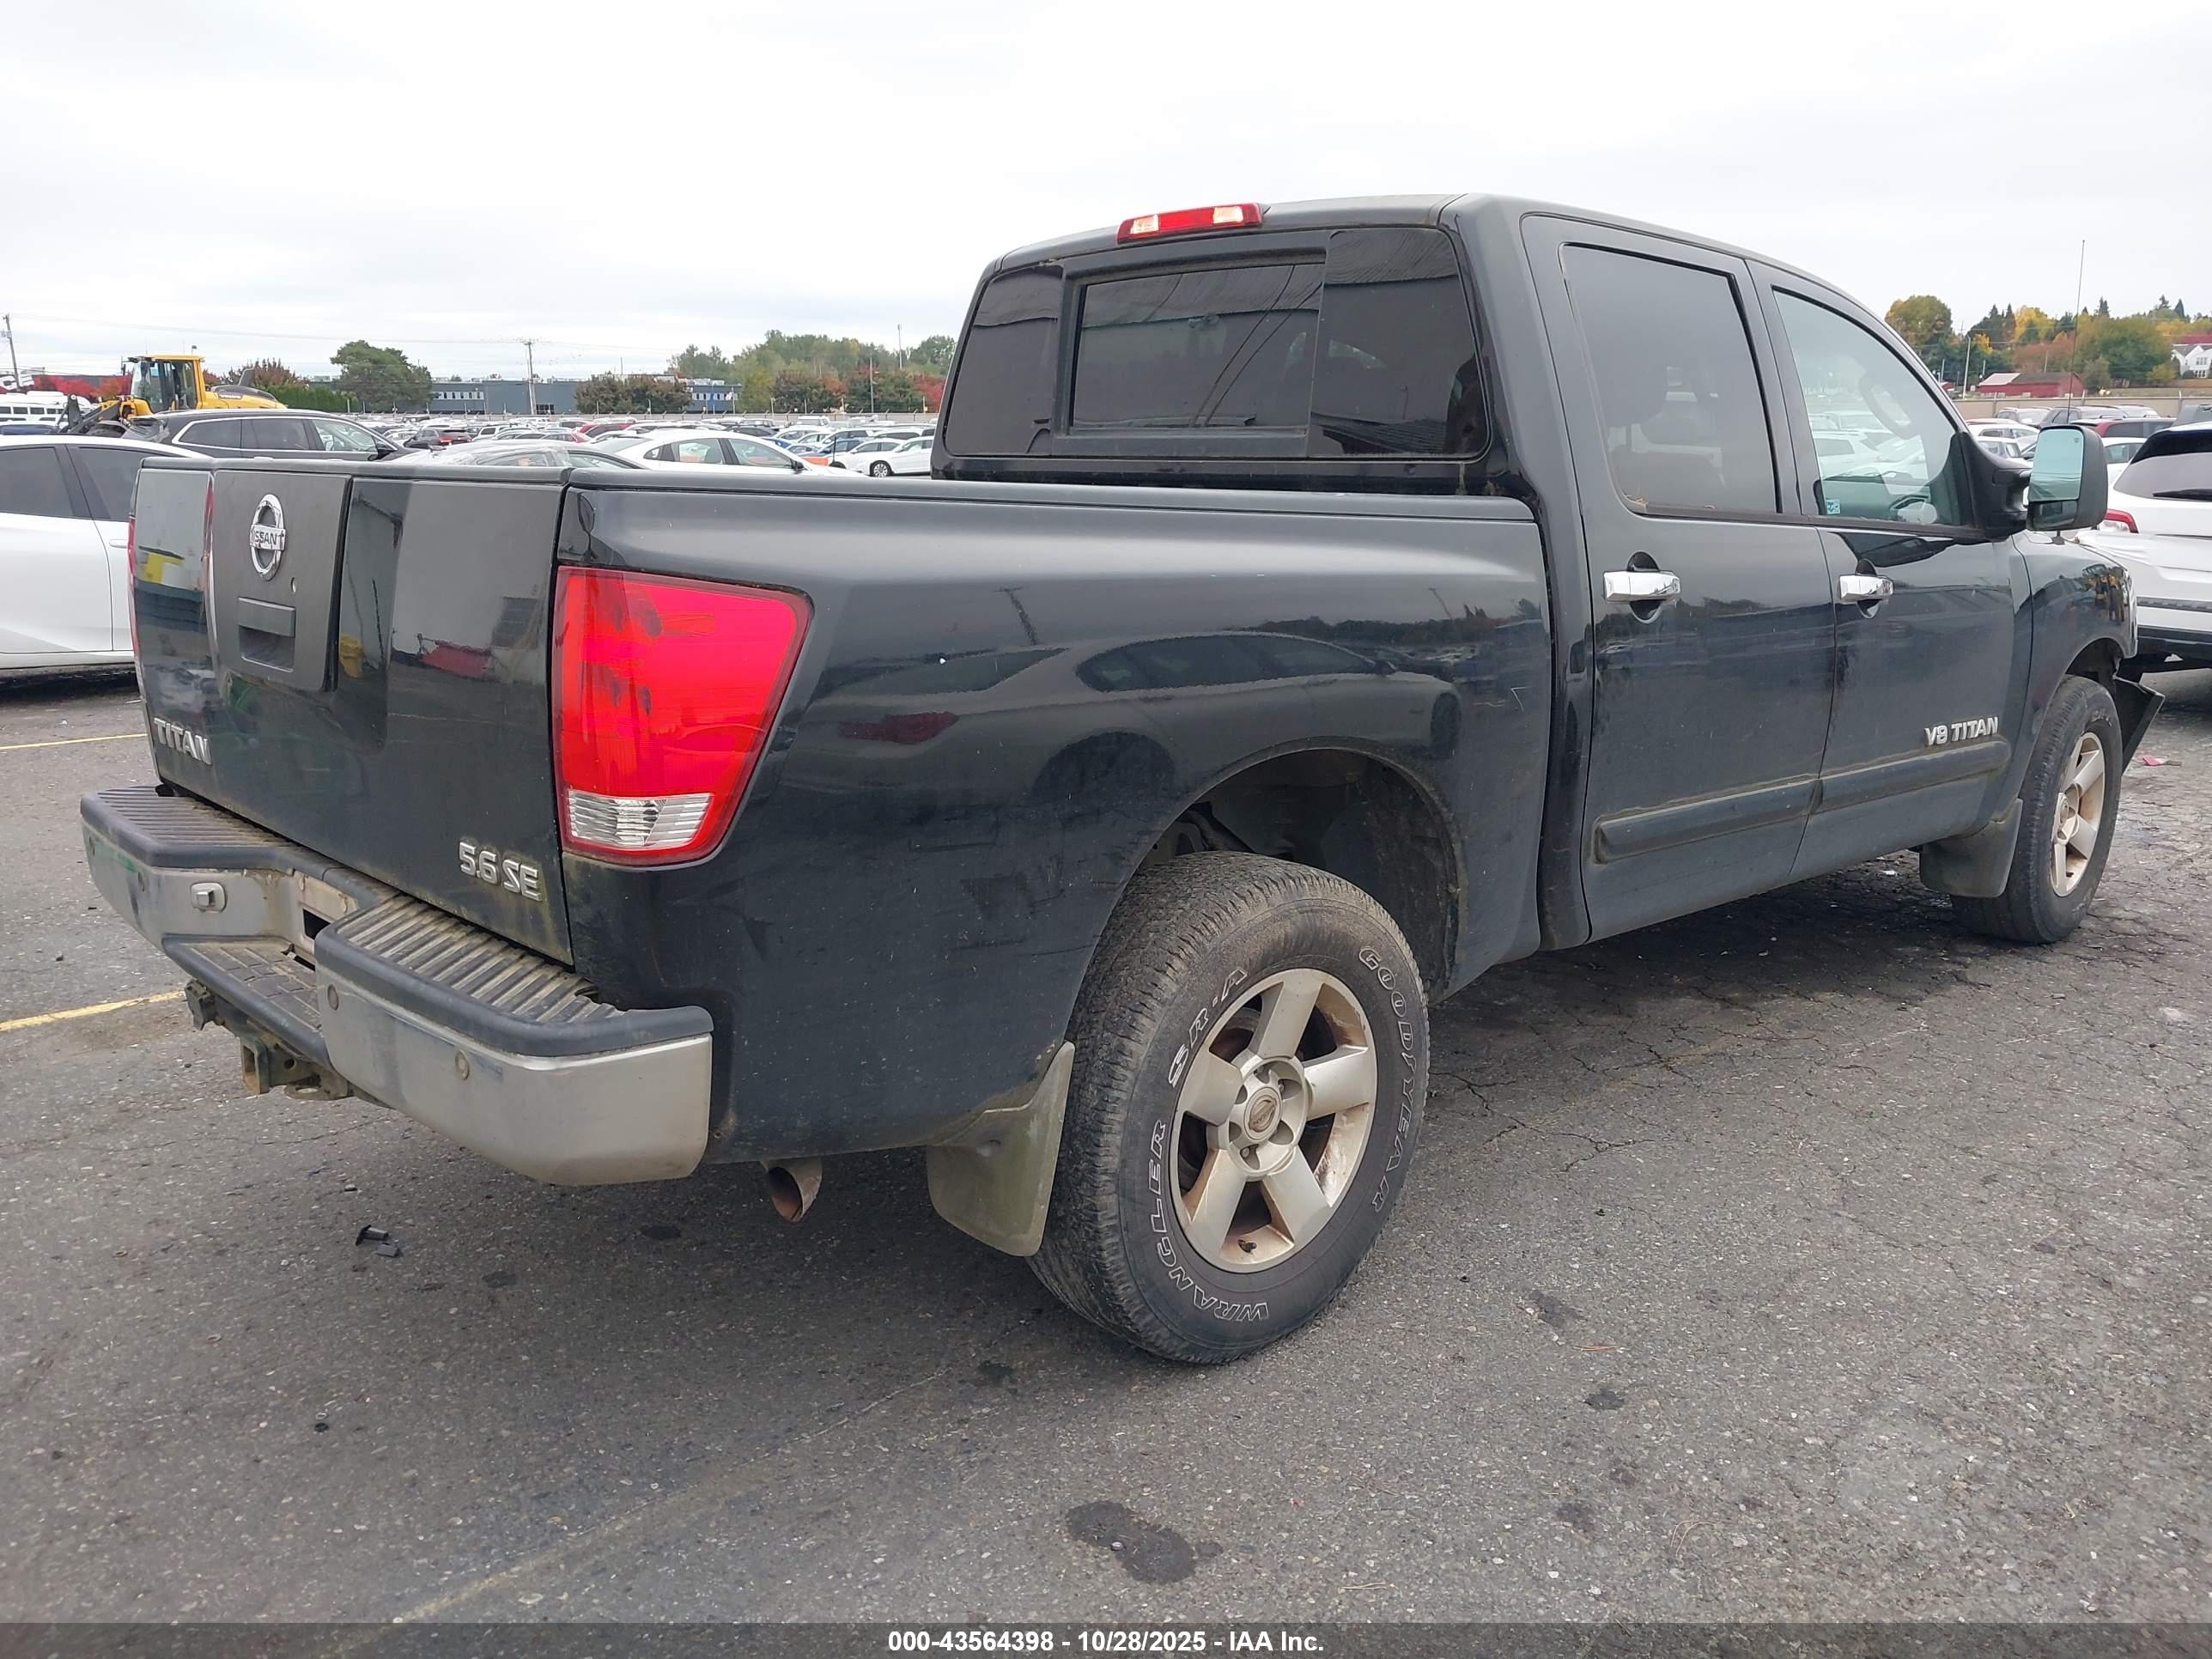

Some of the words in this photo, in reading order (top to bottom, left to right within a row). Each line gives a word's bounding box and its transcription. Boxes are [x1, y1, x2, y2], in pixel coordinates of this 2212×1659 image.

[154, 717, 213, 765] TITAN
[1924, 725, 1948, 746] V8
[1950, 716, 1999, 742] TITAN
[459, 842, 499, 884] 5.6
[501, 859, 543, 902] SE
[1358, 947, 1418, 1212] GOODYEAR
[1149, 1119, 1270, 1322] WRANGLER
